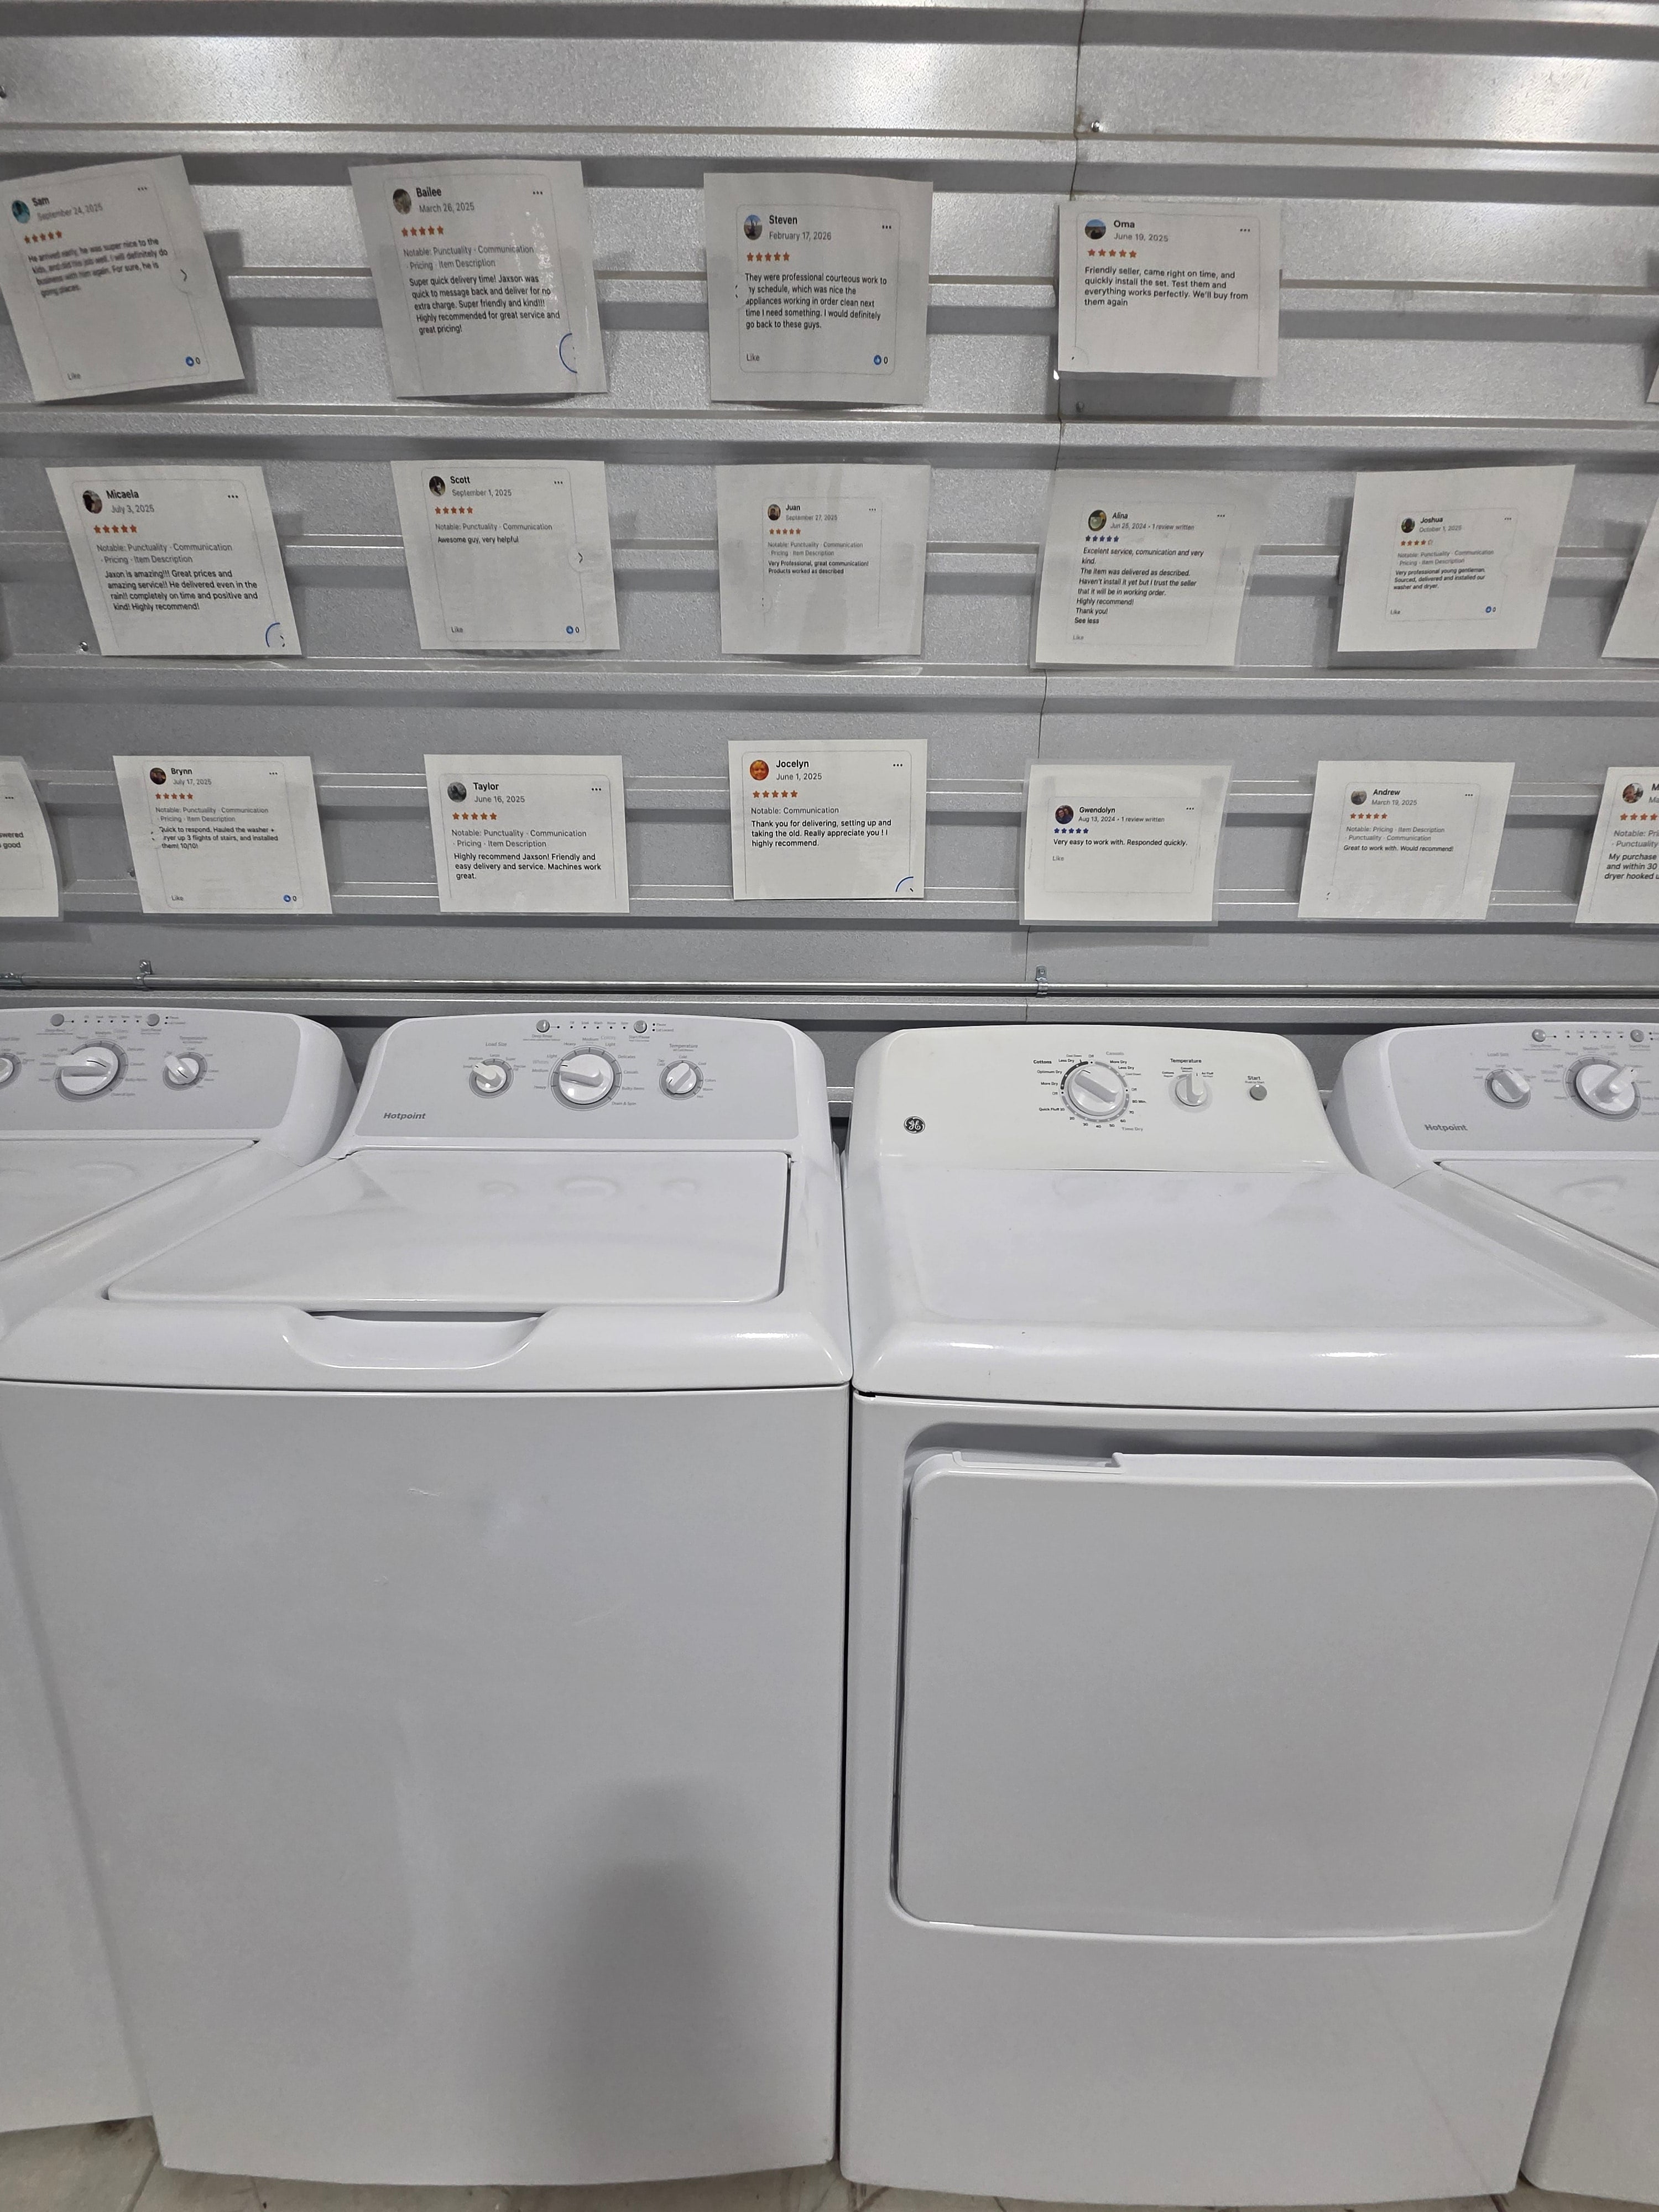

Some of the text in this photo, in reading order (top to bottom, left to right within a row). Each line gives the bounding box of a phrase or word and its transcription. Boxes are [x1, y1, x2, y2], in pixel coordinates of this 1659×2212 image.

[416, 187, 441, 197] Bailee
[32, 197, 50, 206] Sam
[37, 209, 72, 221] September
[85, 202, 103, 213] 2025
[419, 202, 474, 213] March 26, 2025
[769, 215, 797, 224] Steven
[770, 231, 831, 242] February 17, 2026
[745, 273, 761, 283] They
[782, 273, 823, 282] professional
[1086, 267, 1117, 275] Friendly
[1119, 267, 1141, 276] seller,
[1167, 270, 1185, 278] right
[1199, 270, 1218, 279] time,
[409, 278, 428, 288] Super
[430, 276, 448, 286] quick
[450, 276, 477, 285] delivery
[478, 275, 496, 283] time!
[432, 301, 457, 310] charge.
[458, 300, 478, 309] Super
[481, 299, 506, 309] friendly
[508, 299, 521, 307] and
[1107, 299, 1128, 307] again
[783, 320, 801, 328] these
[419, 325, 462, 335] great pricing!
[106, 489, 139, 499] Micaela
[452, 489, 486, 498] September
[112, 504, 154, 514] July 3, 2025
[134, 570, 170, 579] amazing!!!
[194, 570, 216, 578] prices
[776, 760, 808, 769] Jocelyn
[473, 782, 499, 791] Taylor
[552, 853, 580, 862] Friendly
